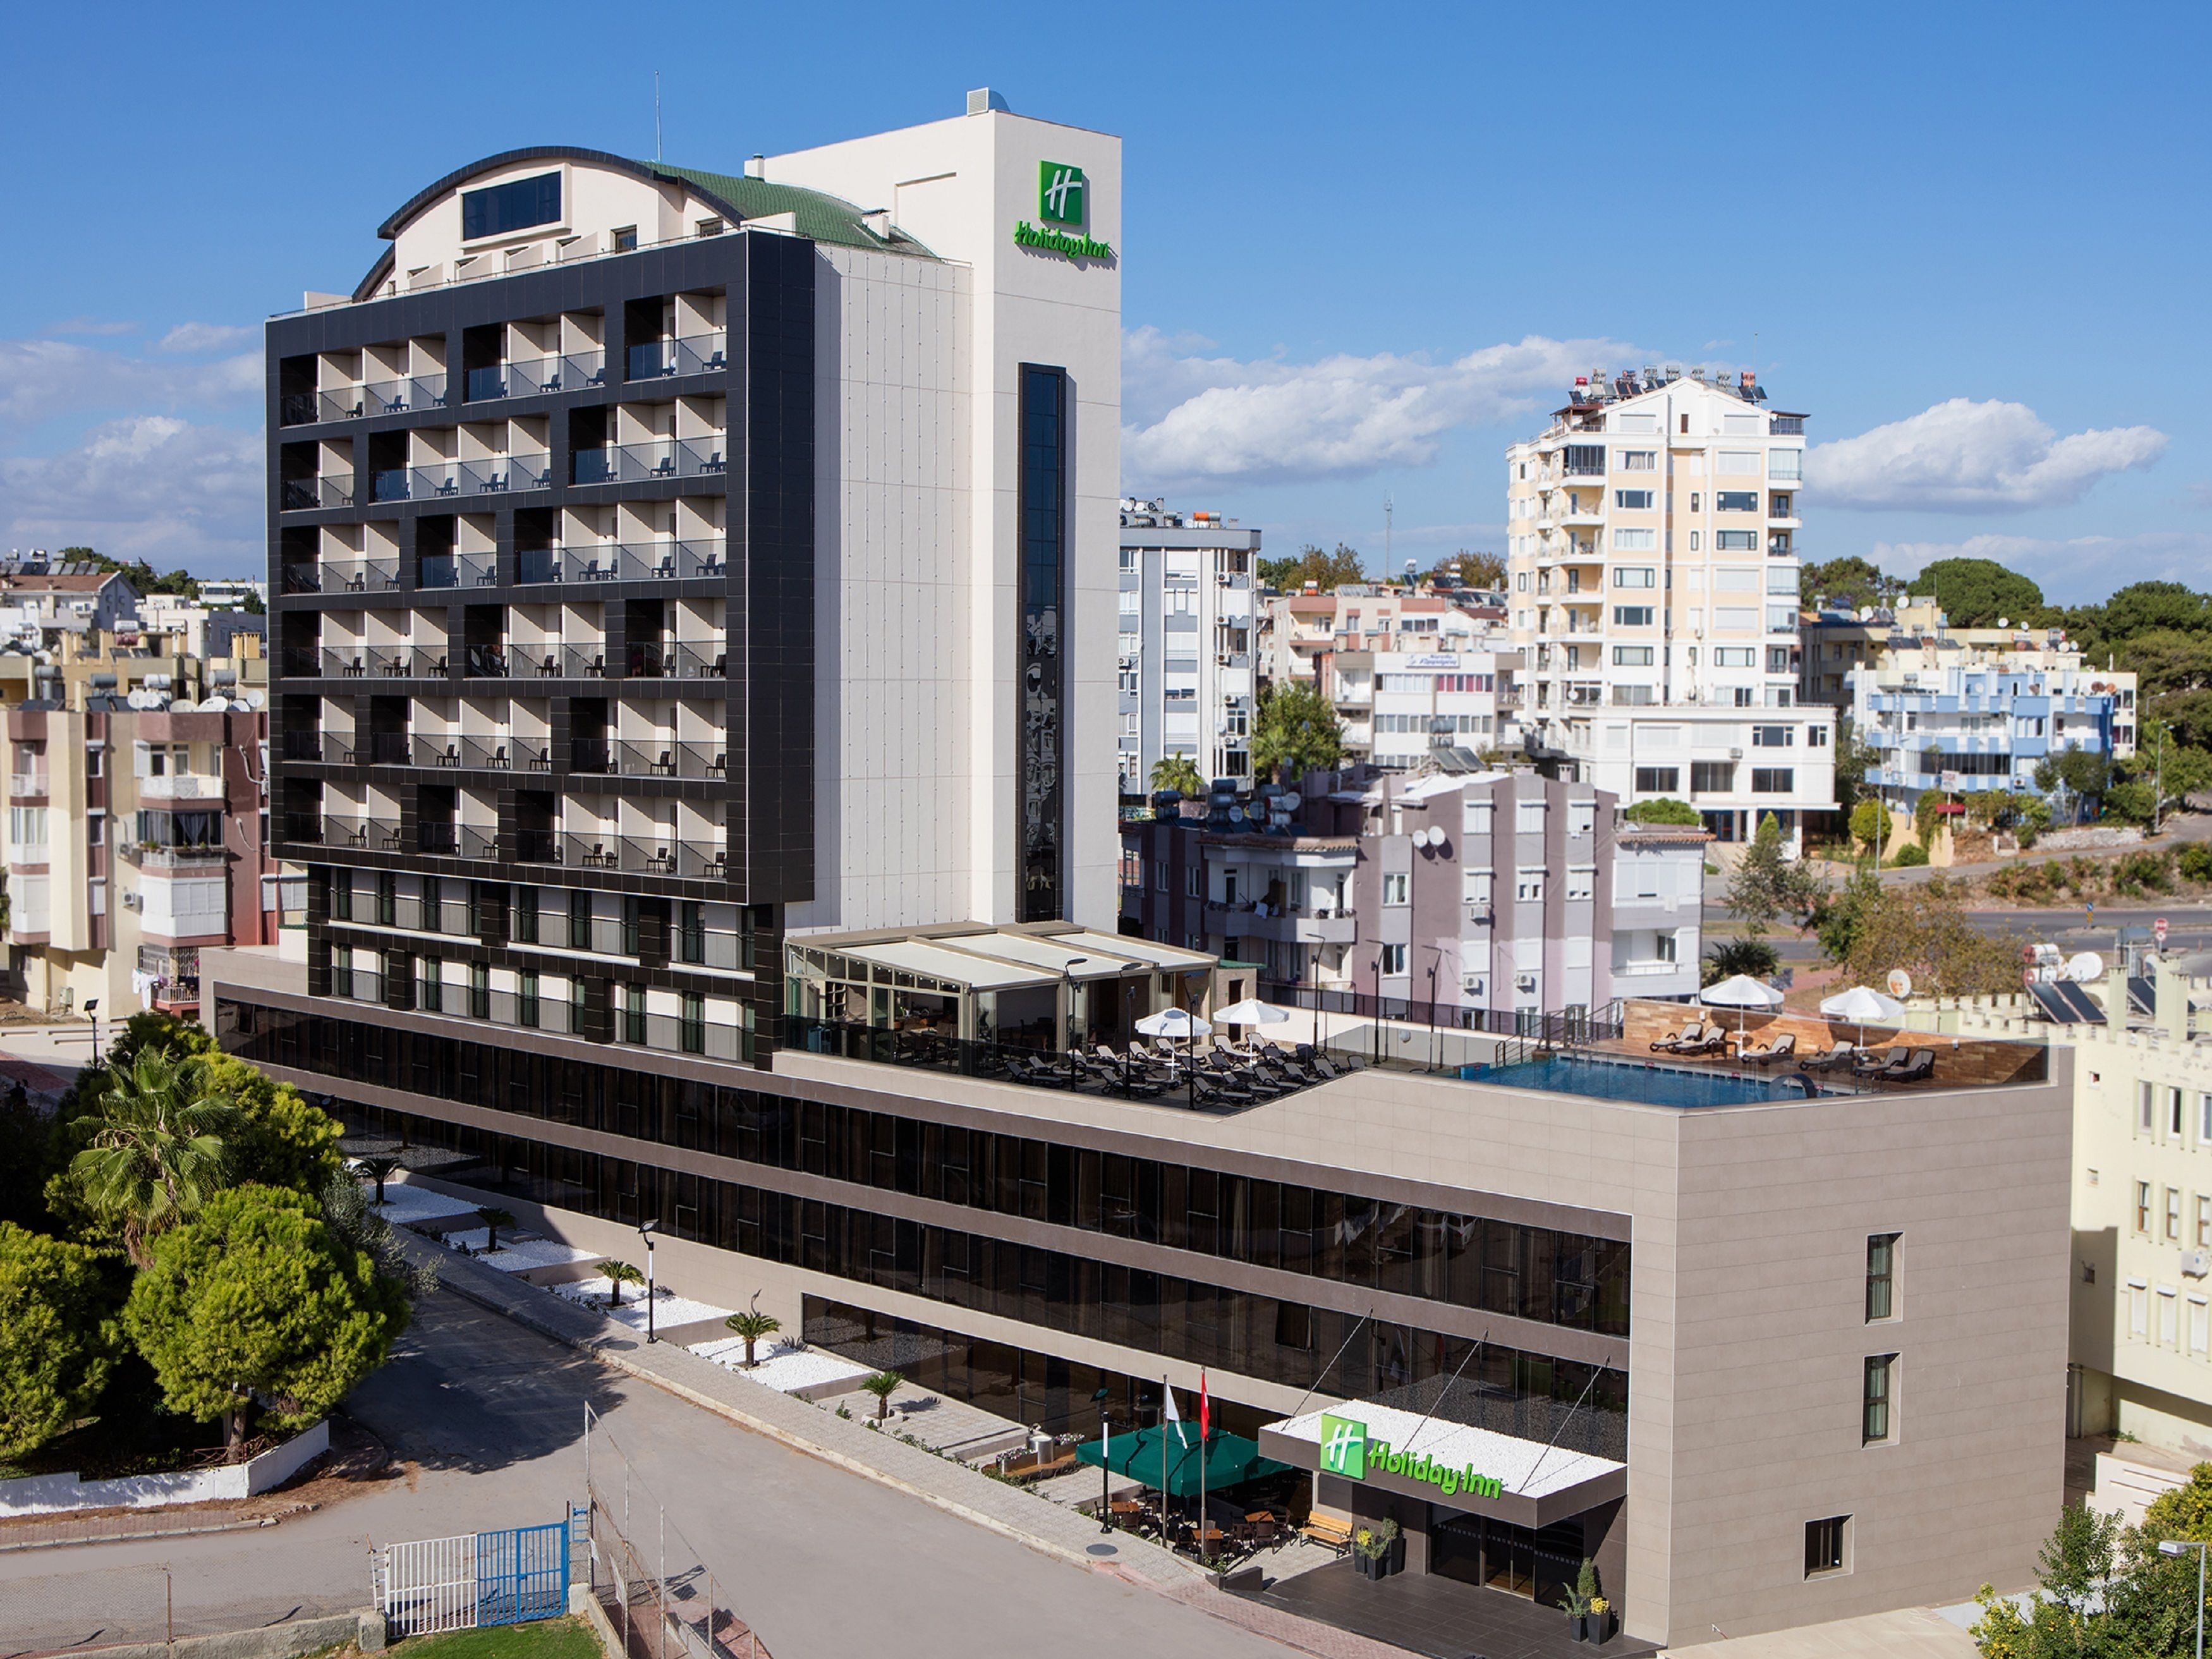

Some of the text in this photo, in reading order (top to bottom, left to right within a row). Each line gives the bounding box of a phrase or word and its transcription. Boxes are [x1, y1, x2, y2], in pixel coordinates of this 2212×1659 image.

[1045, 169, 1082, 218] H
[1014, 221, 1109, 258] Holiday Inn
[1325, 1424, 1363, 1471] H
[1368, 1439, 1502, 1500] Holiday Inn
